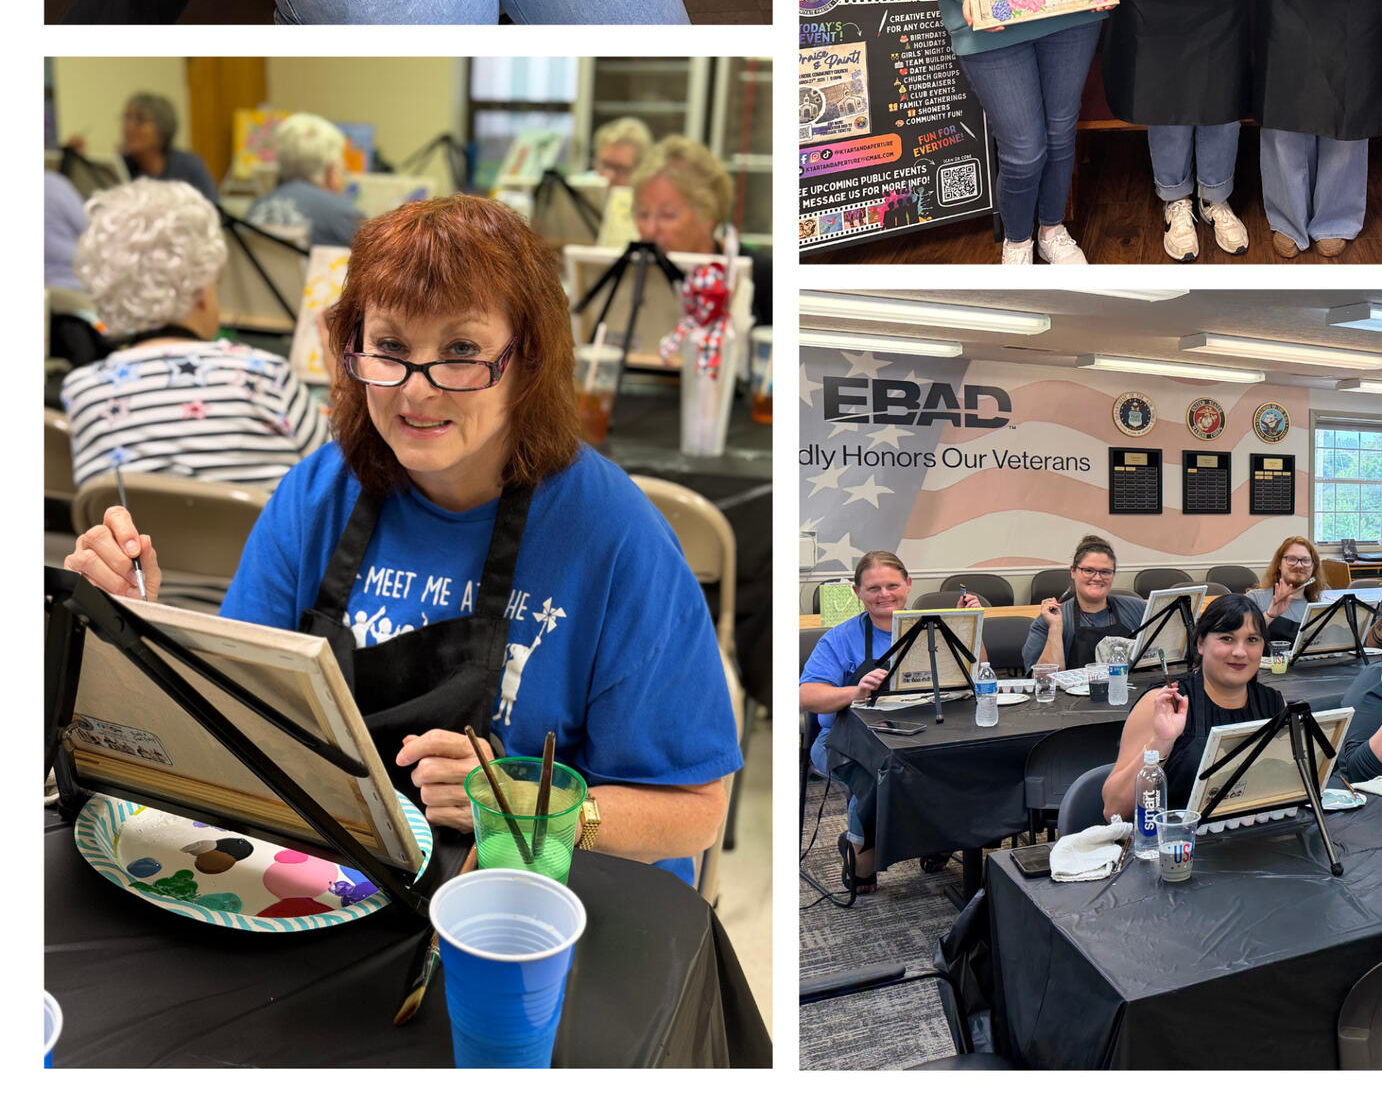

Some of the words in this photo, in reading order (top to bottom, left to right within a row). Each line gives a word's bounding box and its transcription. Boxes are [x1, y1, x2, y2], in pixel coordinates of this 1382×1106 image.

[890, 12, 925, 23] CREATIVE
[926, 10, 941, 19] EVE
[887, 24, 902, 34] FOR
[903, 23, 919, 32] ANY
[920, 20, 944, 30] OCCAS
[910, 31, 947, 42] BIRTHDAYS
[913, 39, 946, 49] HOLIDAYS
[924, 47, 944, 56] NIGHT
[825, 50, 861, 70] Paint!
[905, 58, 924, 67] TEAM
[925, 54, 957, 64] BUILDING
[903, 73, 932, 84] CHURCH
[933, 69, 960, 80] GROUPS
[909, 66, 927, 75] DATE
[928, 62, 953, 72] NIGHTS
[908, 78, 956, 92] FUNDRAISERS
[910, 90, 928, 99] CLUB
[929, 87, 956, 97] EVENTS
[900, 100, 922, 110] FAMILY
[924, 92, 967, 105] GATHERINGS
[905, 113, 946, 126] COMMUNITY
[947, 109, 963, 118] FUN!
[918, 104, 951, 115] SHOWERS
[917, 133, 936, 145] FUN
[937, 125, 956, 137] FOR
[912, 132, 965, 158] EVERYONE!
[810, 176, 859, 195] UPCOMING
[860, 171, 891, 185] PUBLIC
[893, 164, 928, 179] EVENTS
[802, 192, 847, 209] MESSAGE
[848, 189, 861, 199] US
[862, 185, 880, 197] FOR
[881, 180, 906, 194] MORE
[907, 175, 931, 189] INFO!
[823, 375, 1012, 429] EBAD
[842, 445, 936, 468] Honors
[942, 448, 988, 470] Our
[992, 449, 1092, 472] Veterans
[364, 565, 417, 599] MEET
[421, 575, 452, 606] ME
[460, 579, 481, 613] A
[503, 589, 531, 621] HE
[1143, 789, 1156, 831] smart
